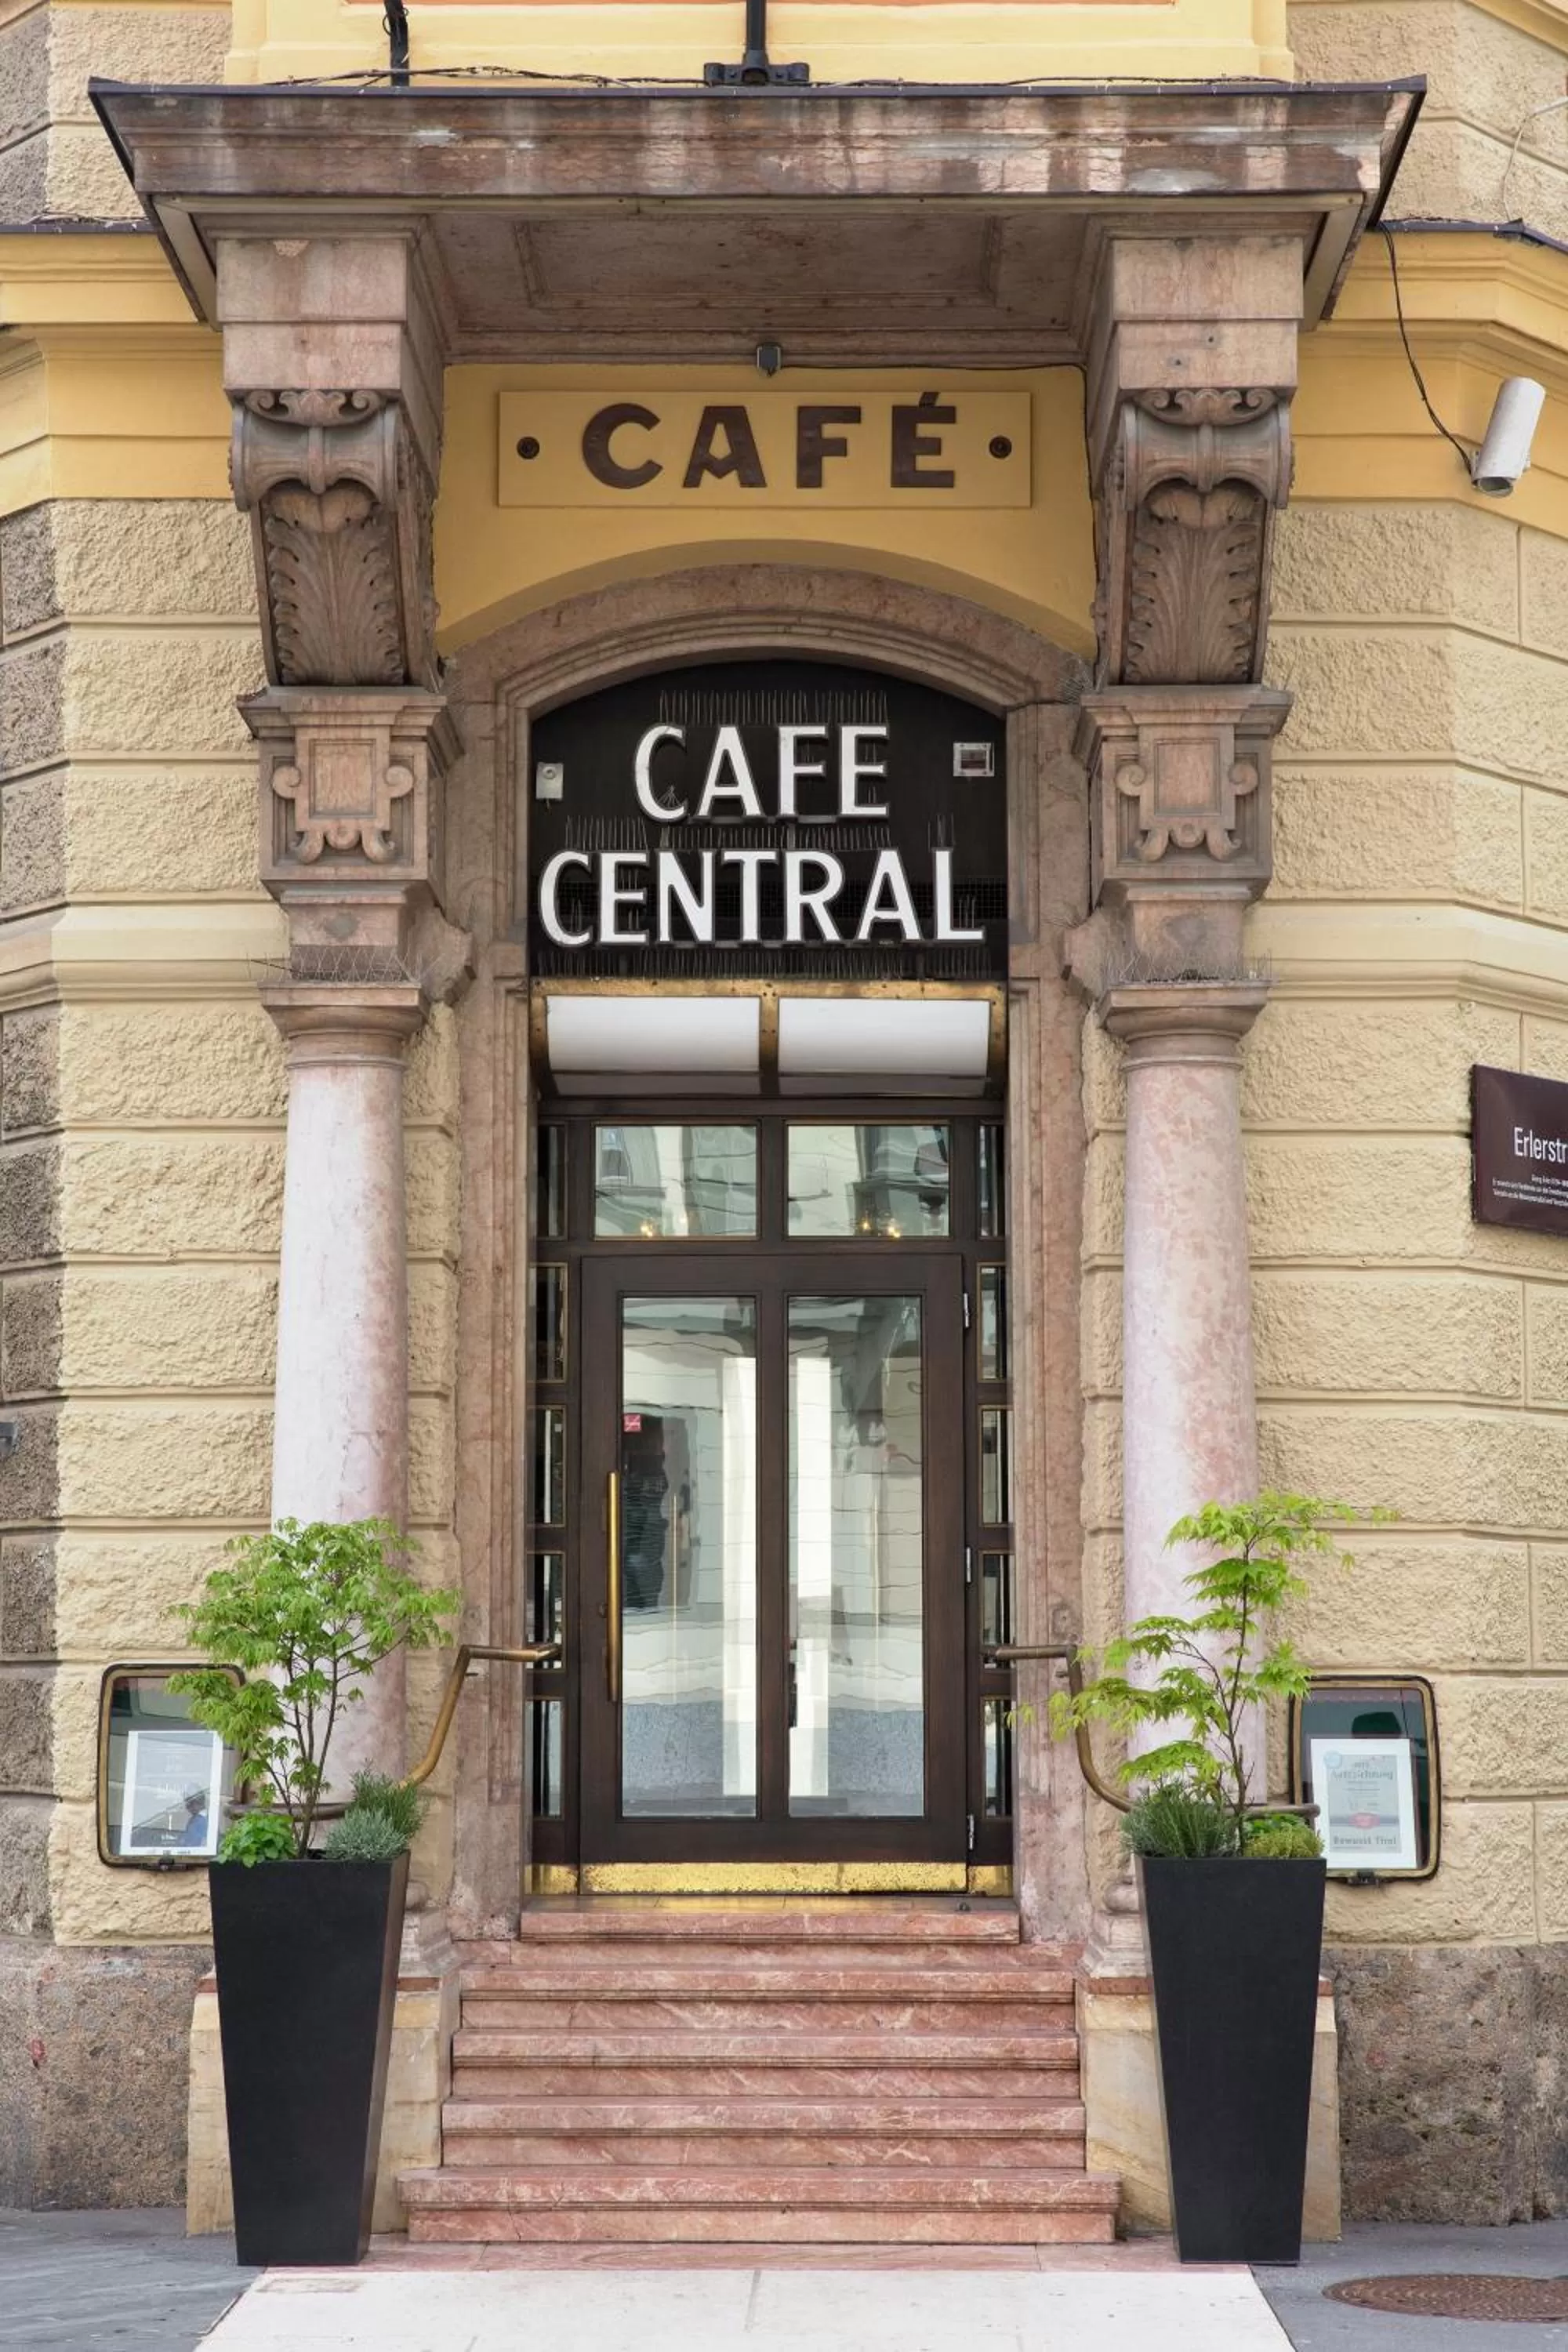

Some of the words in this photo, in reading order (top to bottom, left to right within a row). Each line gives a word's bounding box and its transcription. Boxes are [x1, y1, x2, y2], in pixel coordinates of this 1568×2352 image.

[582, 392, 957, 489] CAFÉ
[634, 725, 888, 820] CAFE
[539, 850, 984, 946] CENTRAL
